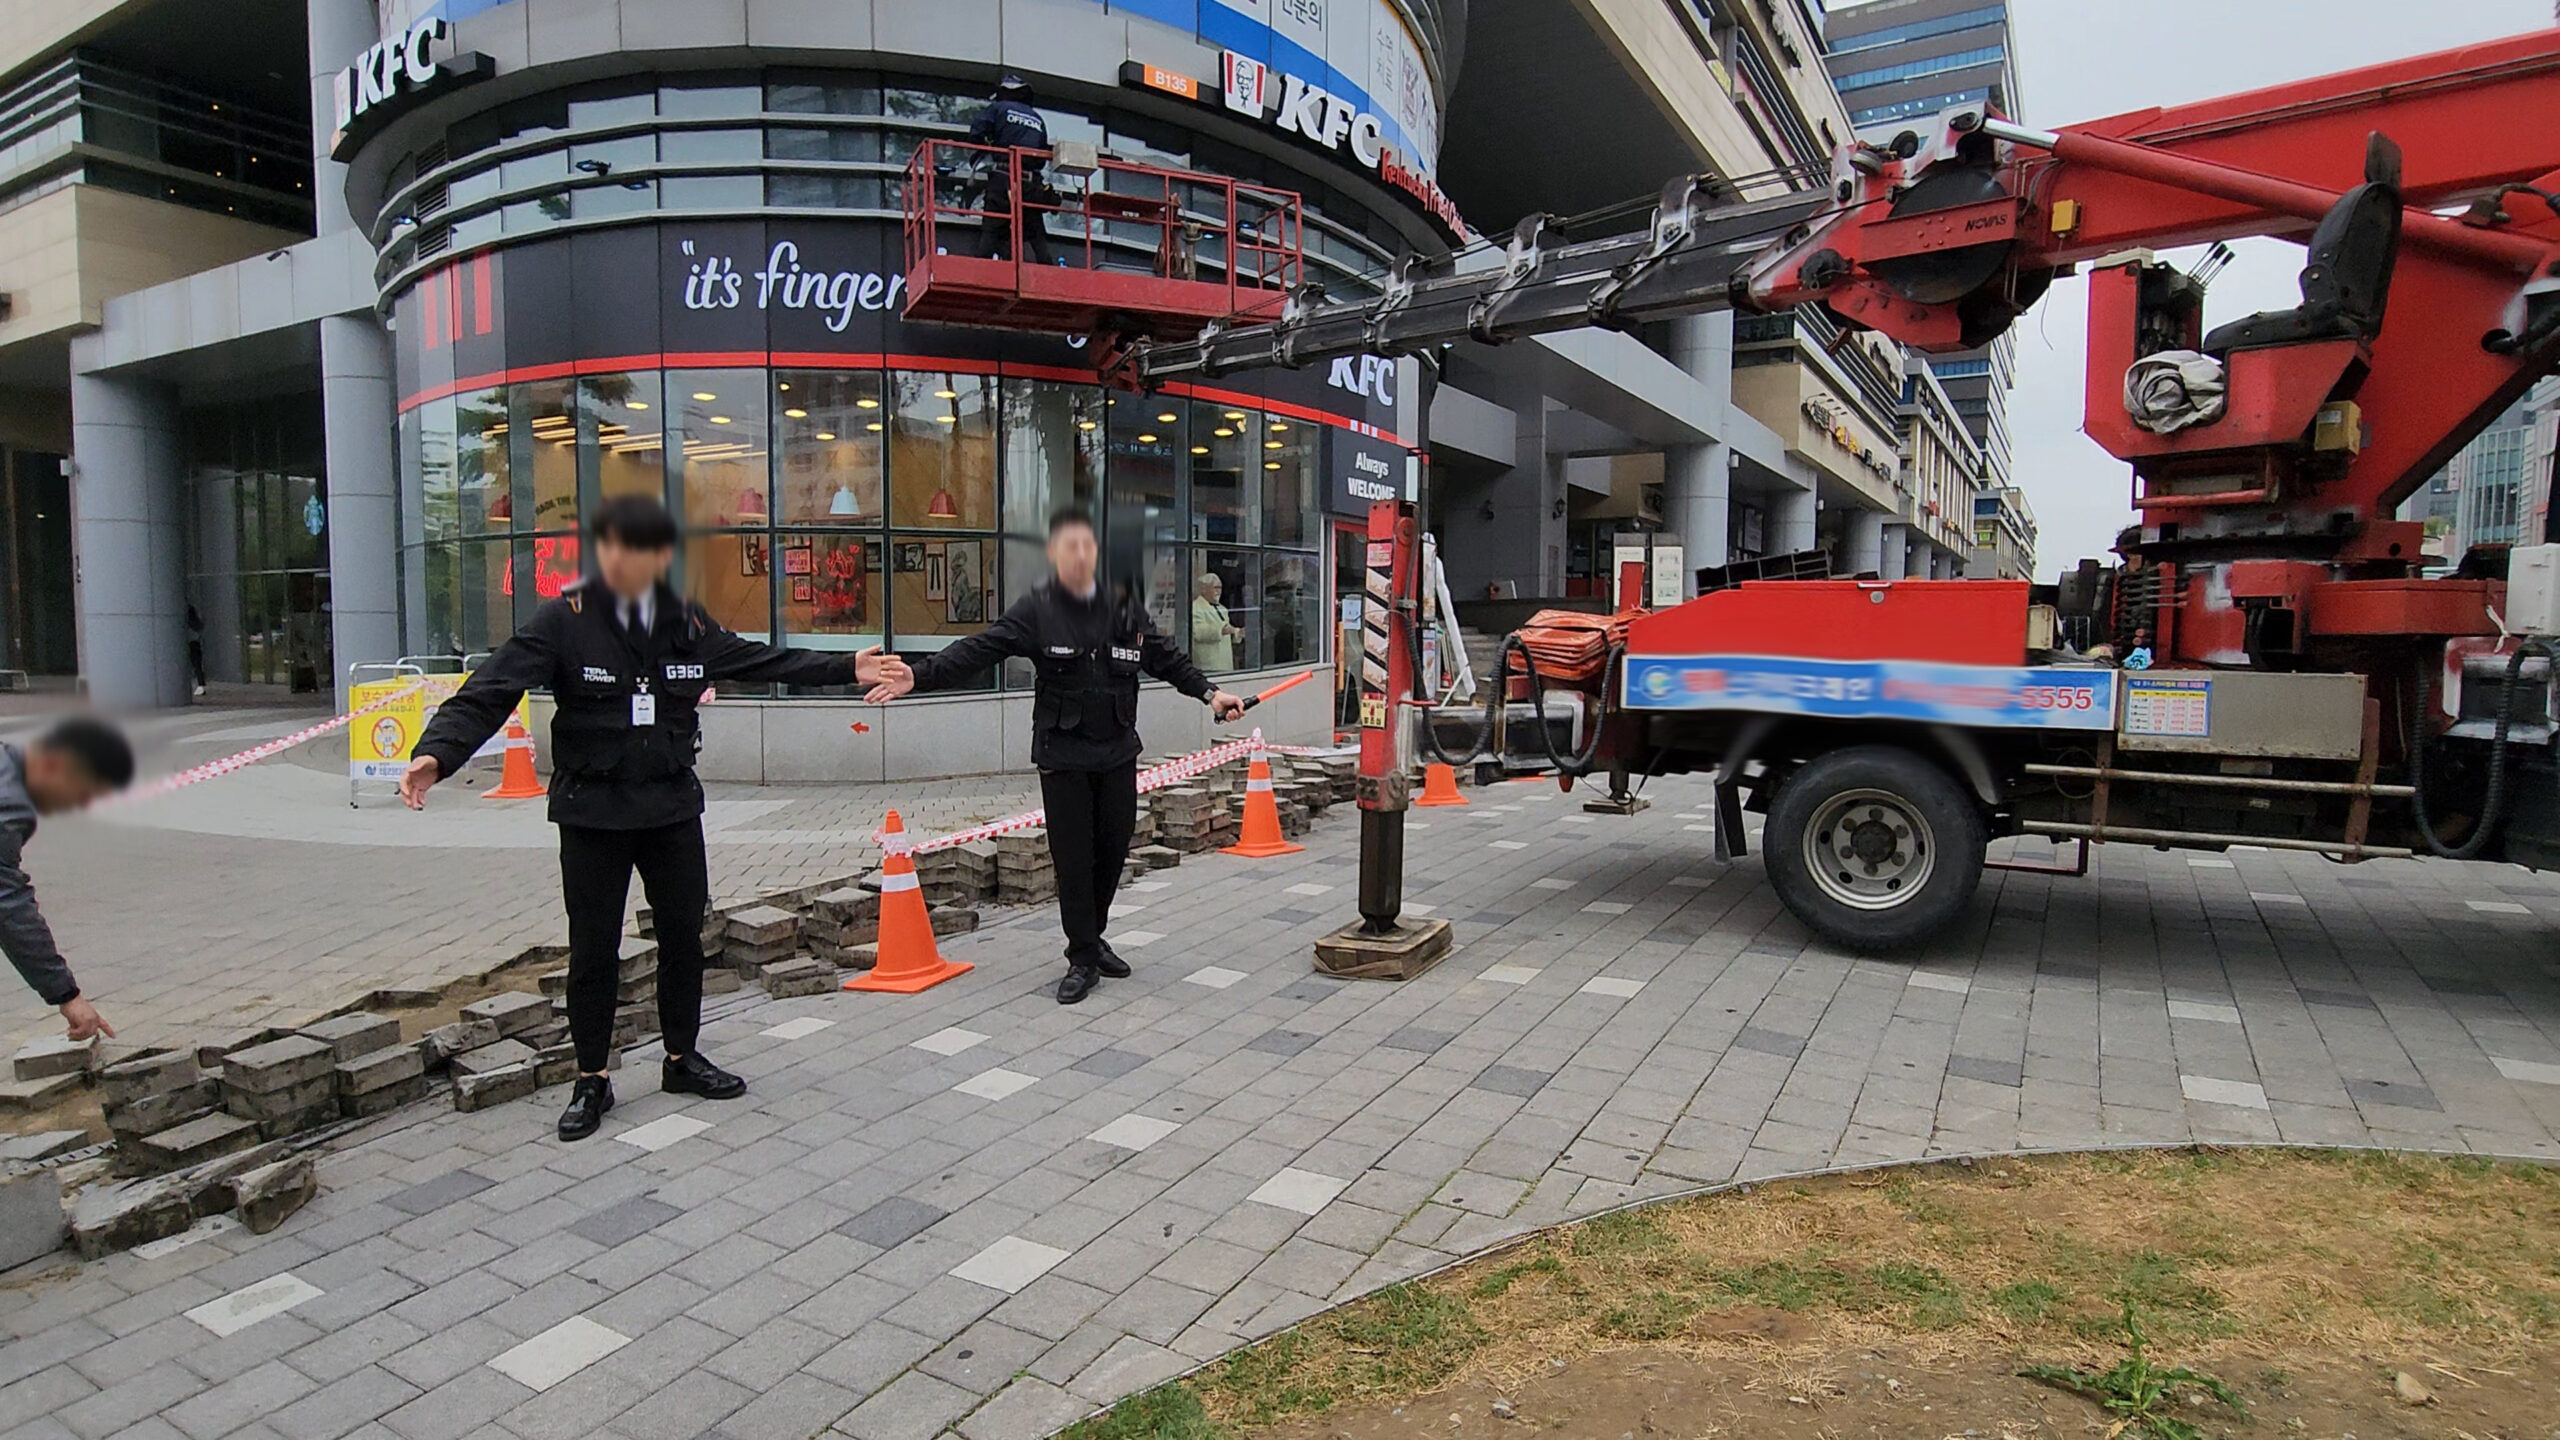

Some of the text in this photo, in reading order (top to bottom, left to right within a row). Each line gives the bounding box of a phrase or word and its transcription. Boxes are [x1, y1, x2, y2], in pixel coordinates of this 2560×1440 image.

[355, 16, 439, 116] KFC
[1154, 70, 1188, 93] B135
[1276, 73, 1382, 168] KFC
[1965, 215, 2007, 232] NOVAS
[1327, 353, 1394, 407] KFC
[1355, 452, 1389, 478] Always
[1347, 477, 1396, 500] WELCOME
[1111, 646, 1141, 662] G360
[583, 666, 608, 675] TERA
[583, 674, 616, 683] TOWER
[666, 664, 704, 680] G360
